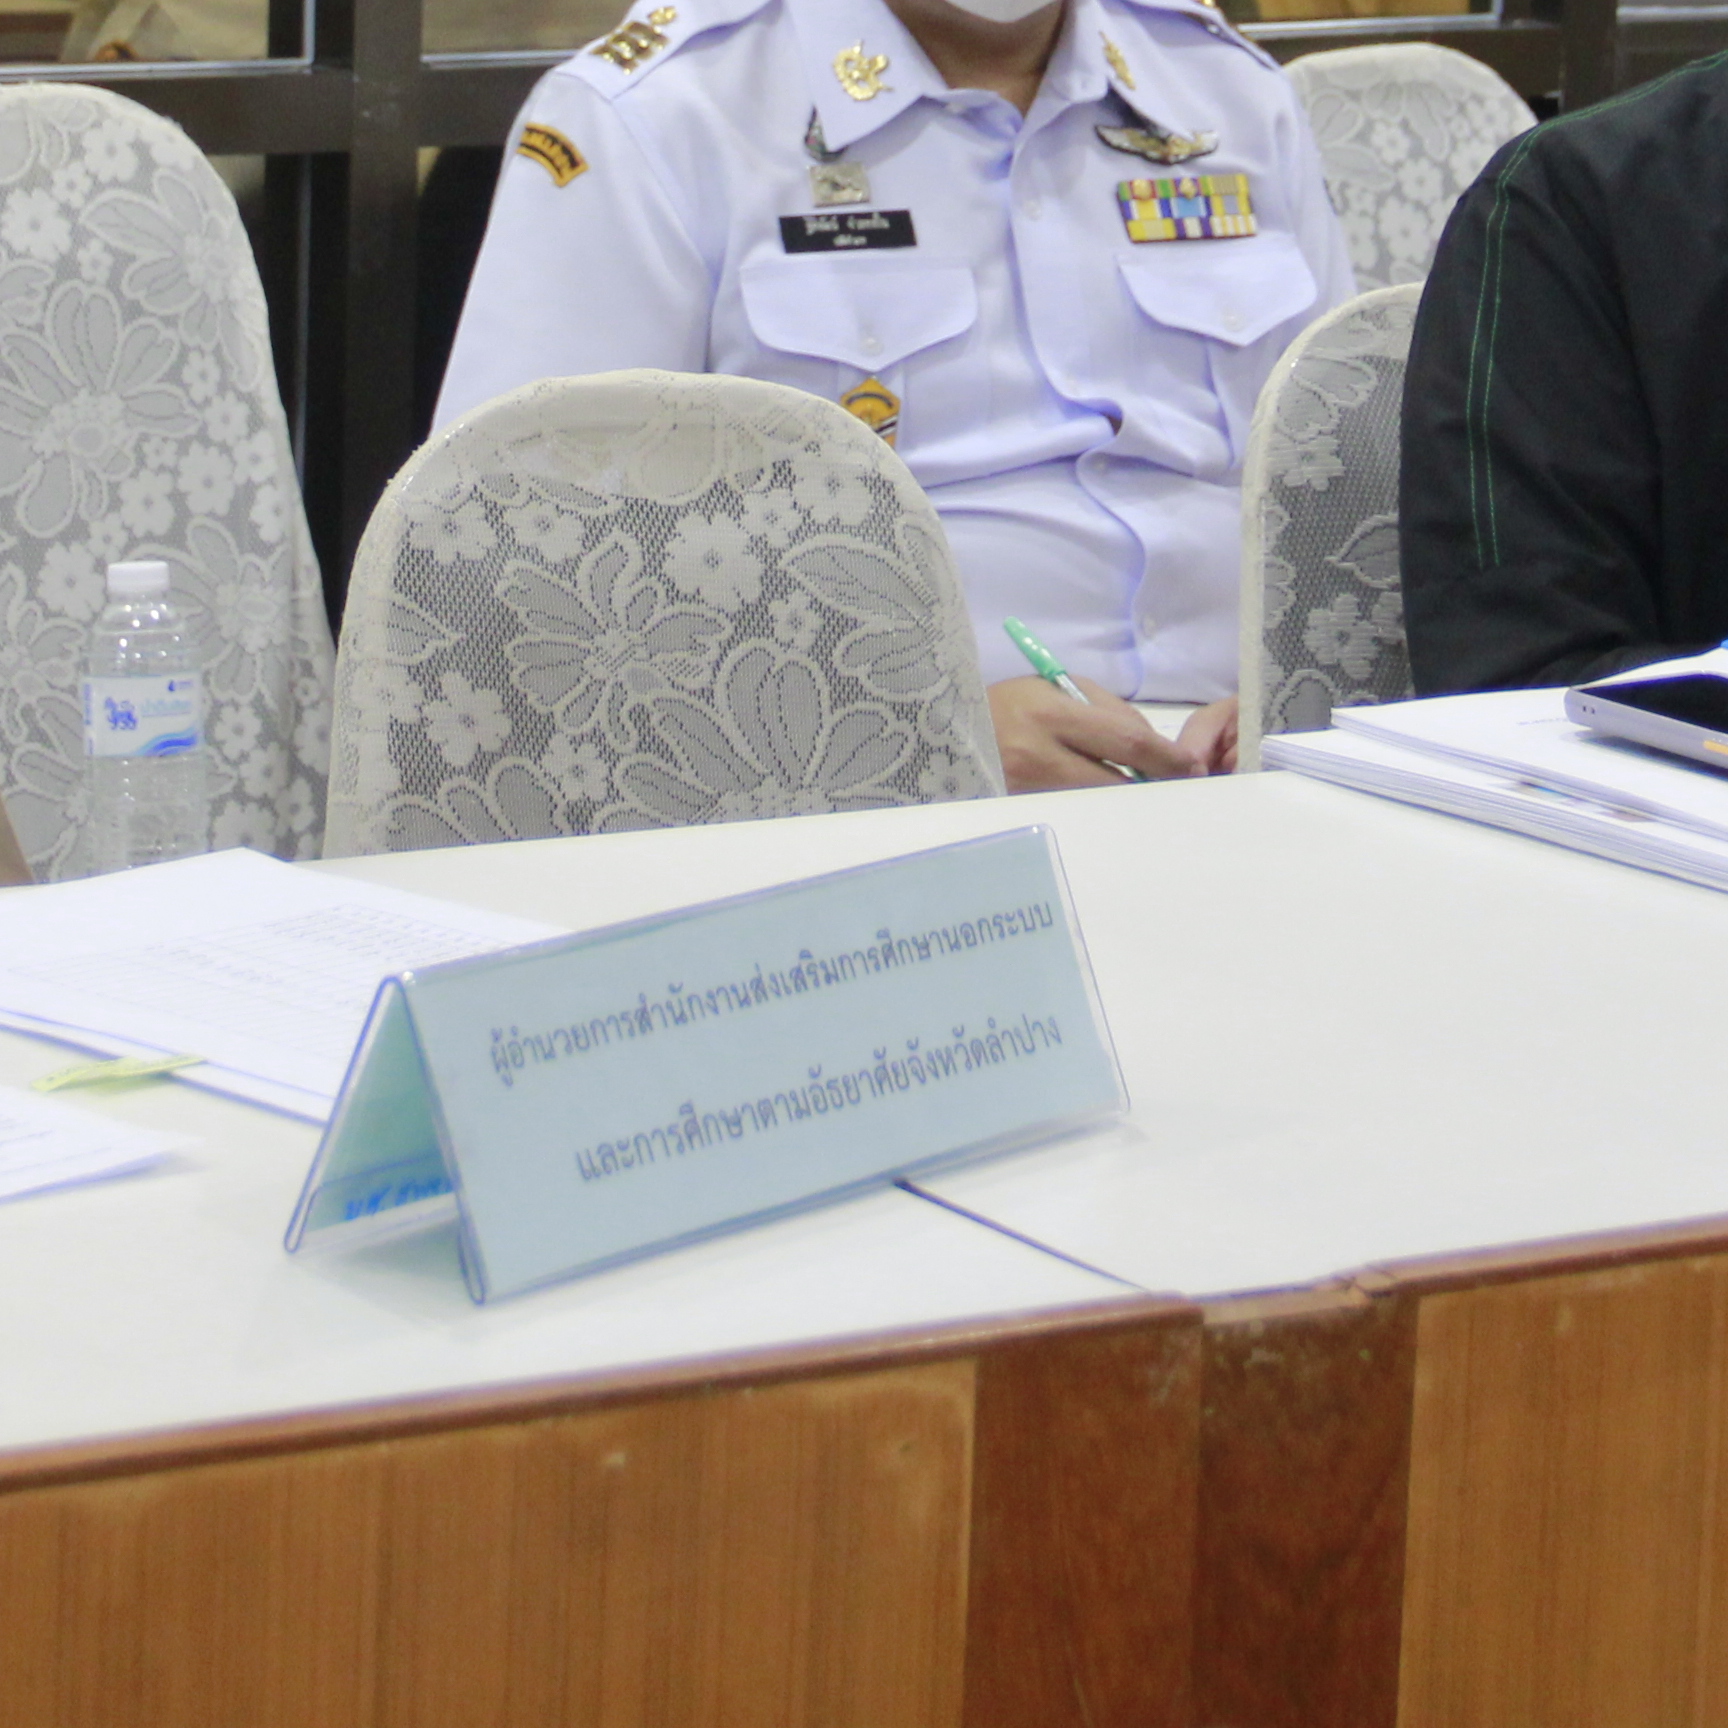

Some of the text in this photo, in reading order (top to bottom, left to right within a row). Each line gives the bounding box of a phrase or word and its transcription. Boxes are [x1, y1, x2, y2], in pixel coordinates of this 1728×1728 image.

[487, 897, 1056, 1092] ผู้อำนวยการสำนักงานส่งเสริมการศึกษานอกระบบ
[575, 1011, 1064, 1183] และการศึกษาตามอัธยาศัยจังหวัดลำปาง
